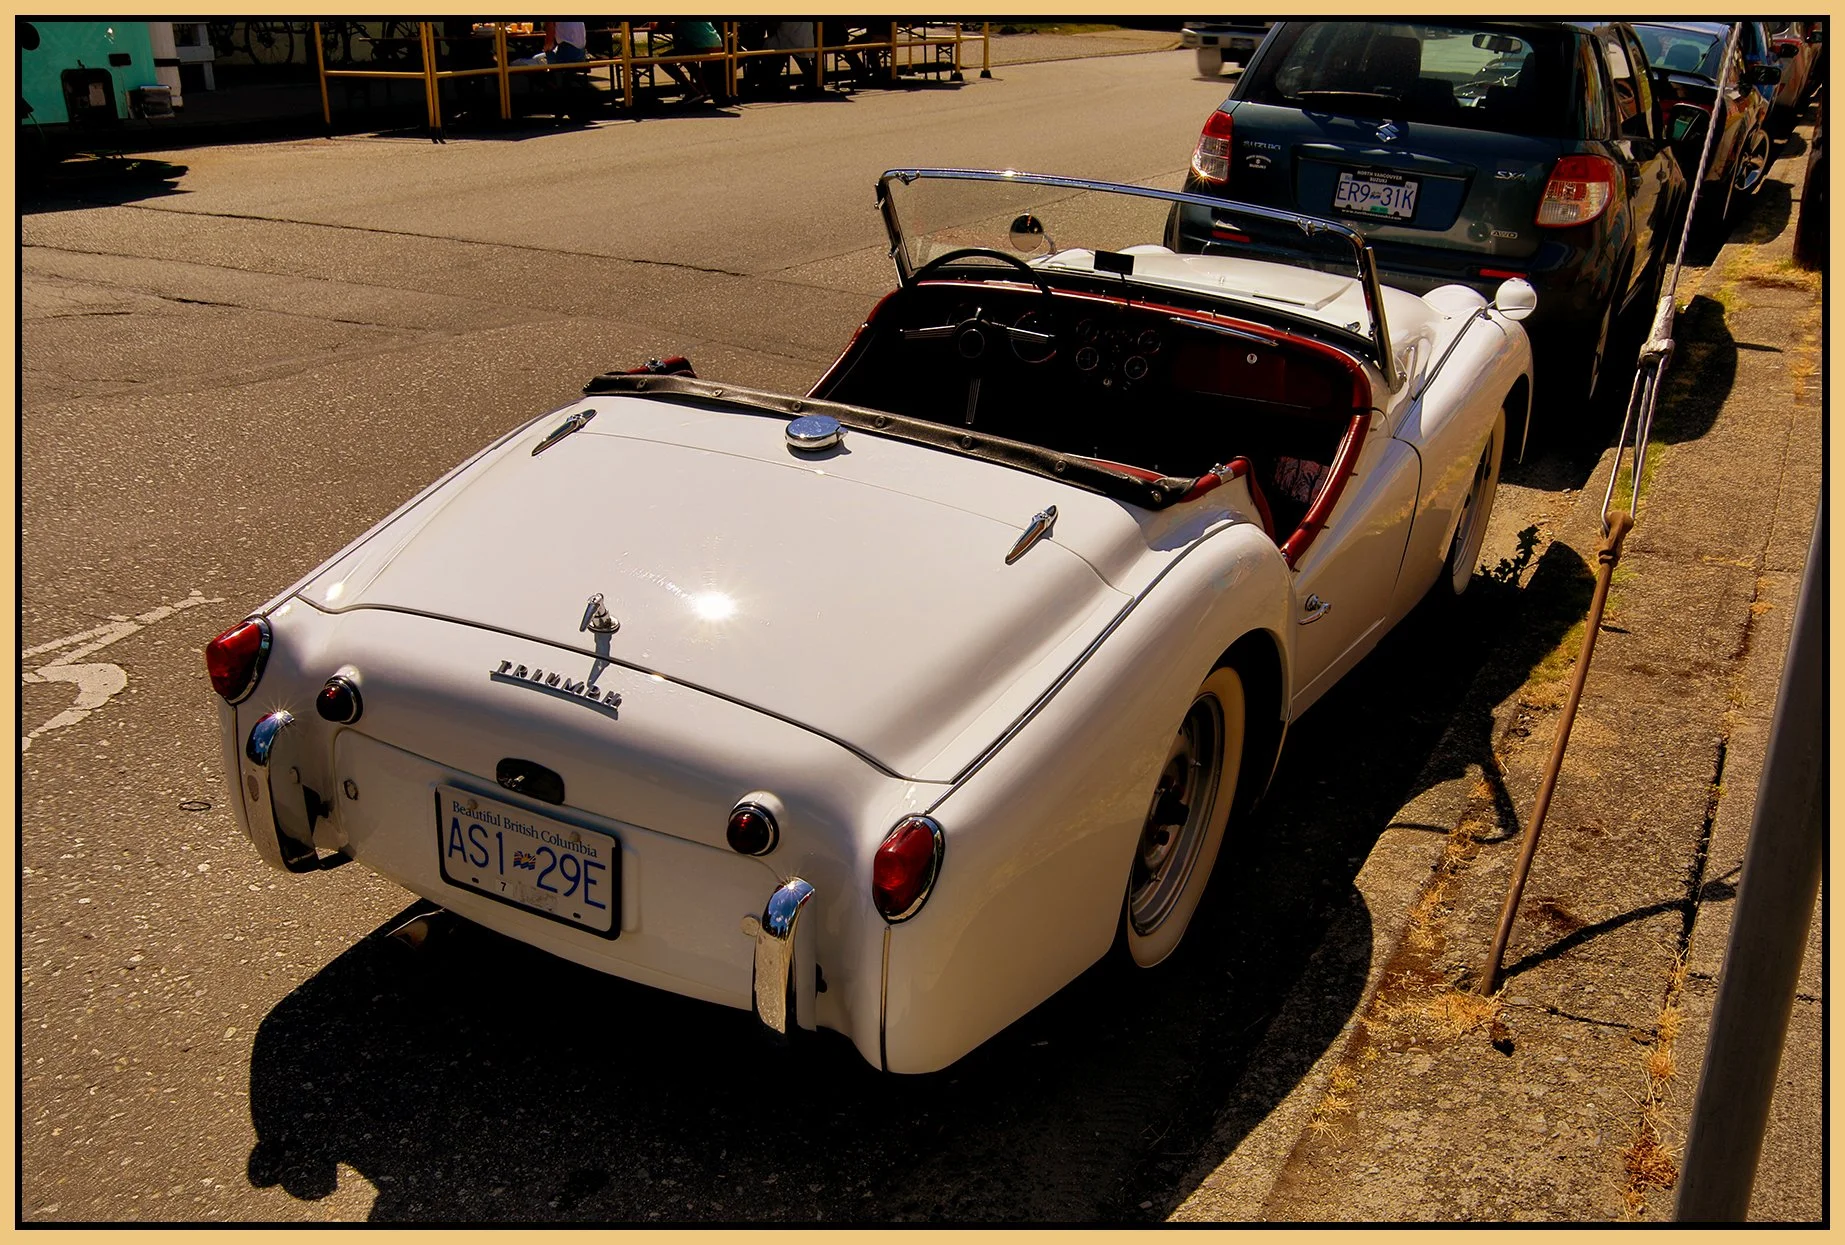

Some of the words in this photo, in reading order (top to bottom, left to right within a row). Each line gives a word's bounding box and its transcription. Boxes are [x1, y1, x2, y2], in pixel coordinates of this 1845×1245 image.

[1337, 181, 1371, 203] ER9
[1381, 187, 1415, 210] 31K
[1374, 172, 1403, 181] VANCOUVER
[496, 660, 623, 709] TRIUMPH
[452, 801, 501, 827] Beautiful
[503, 817, 539, 840] British
[541, 830, 598, 858] Columbia
[448, 816, 504, 875] AS1
[536, 846, 606, 910] 29E
